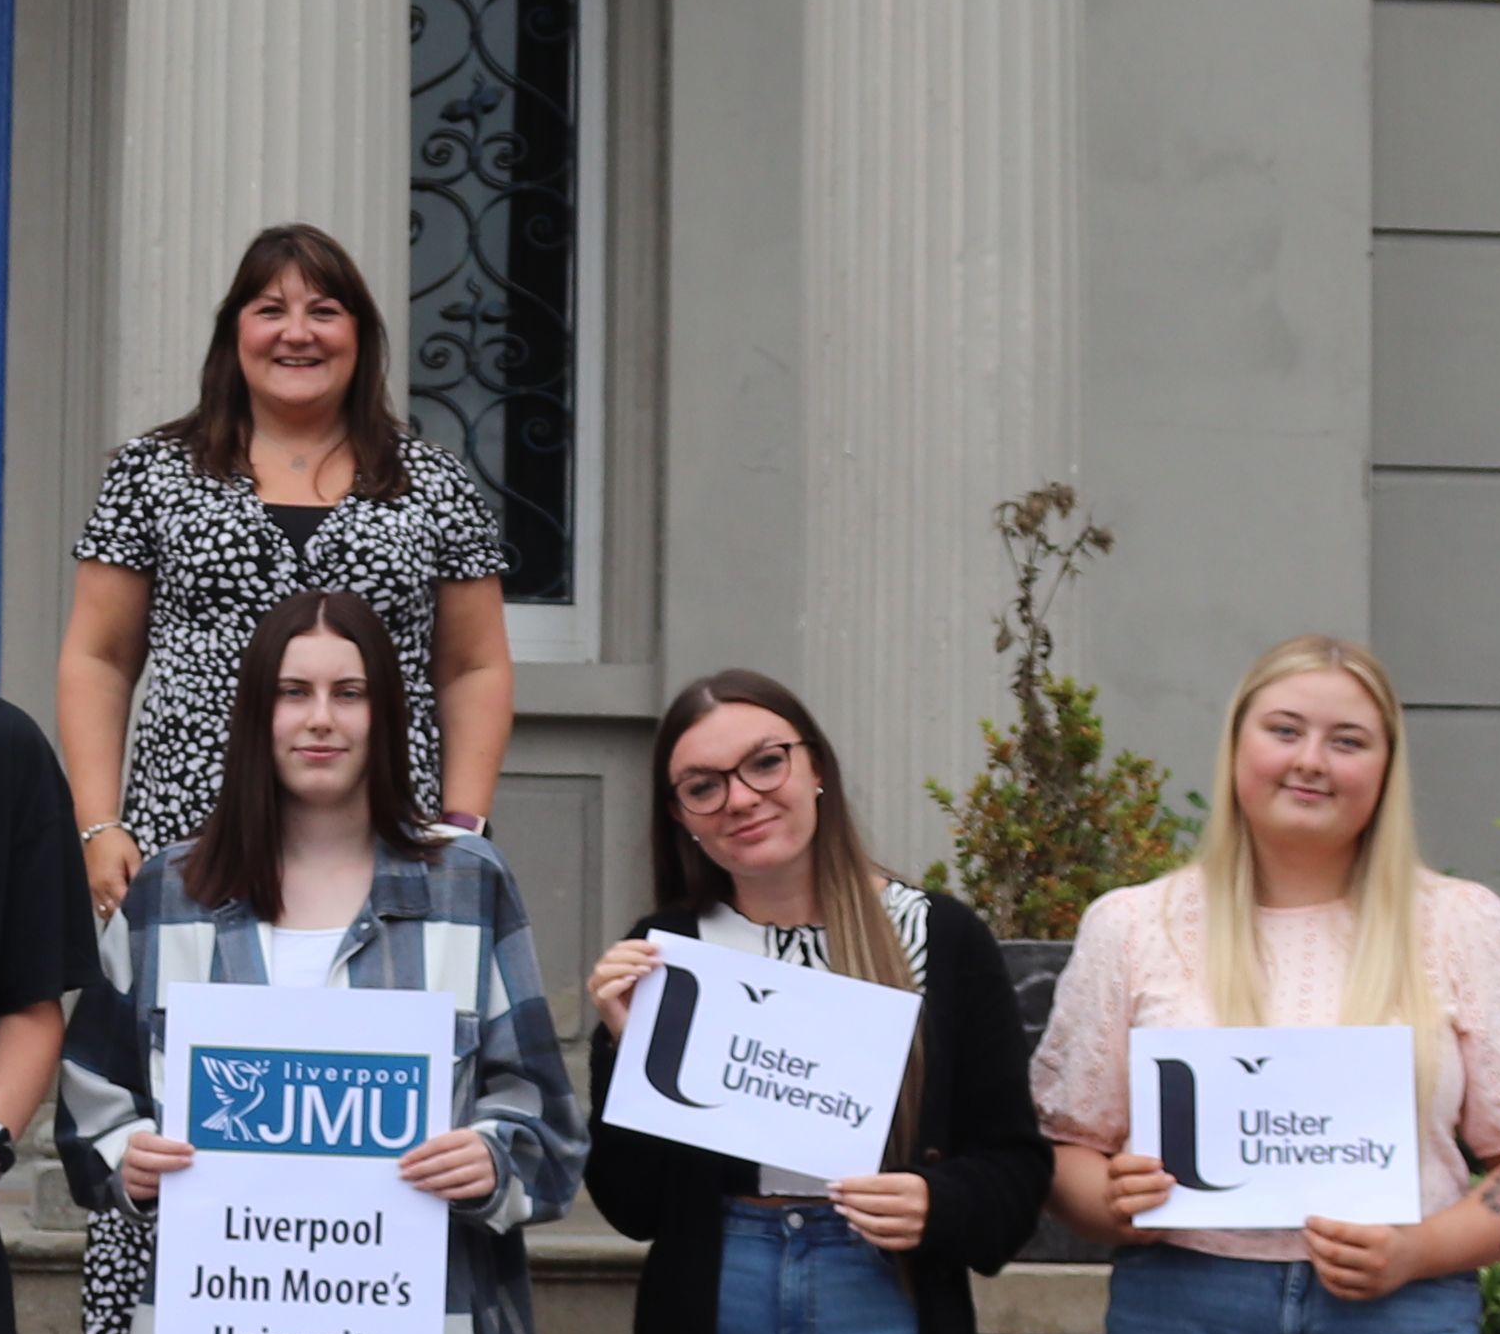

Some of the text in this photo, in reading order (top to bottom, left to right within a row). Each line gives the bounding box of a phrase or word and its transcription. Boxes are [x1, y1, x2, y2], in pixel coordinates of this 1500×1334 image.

[283, 1062, 421, 1085] liverpool
[728, 1033, 821, 1080] Ulster
[258, 1084, 419, 1149] JMU
[722, 1063, 873, 1128] University
[1239, 1109, 1333, 1136] Ulster
[1239, 1137, 1397, 1169] University
[225, 1206, 383, 1253] Liverpool
[190, 1265, 411, 1306] John Moore's
